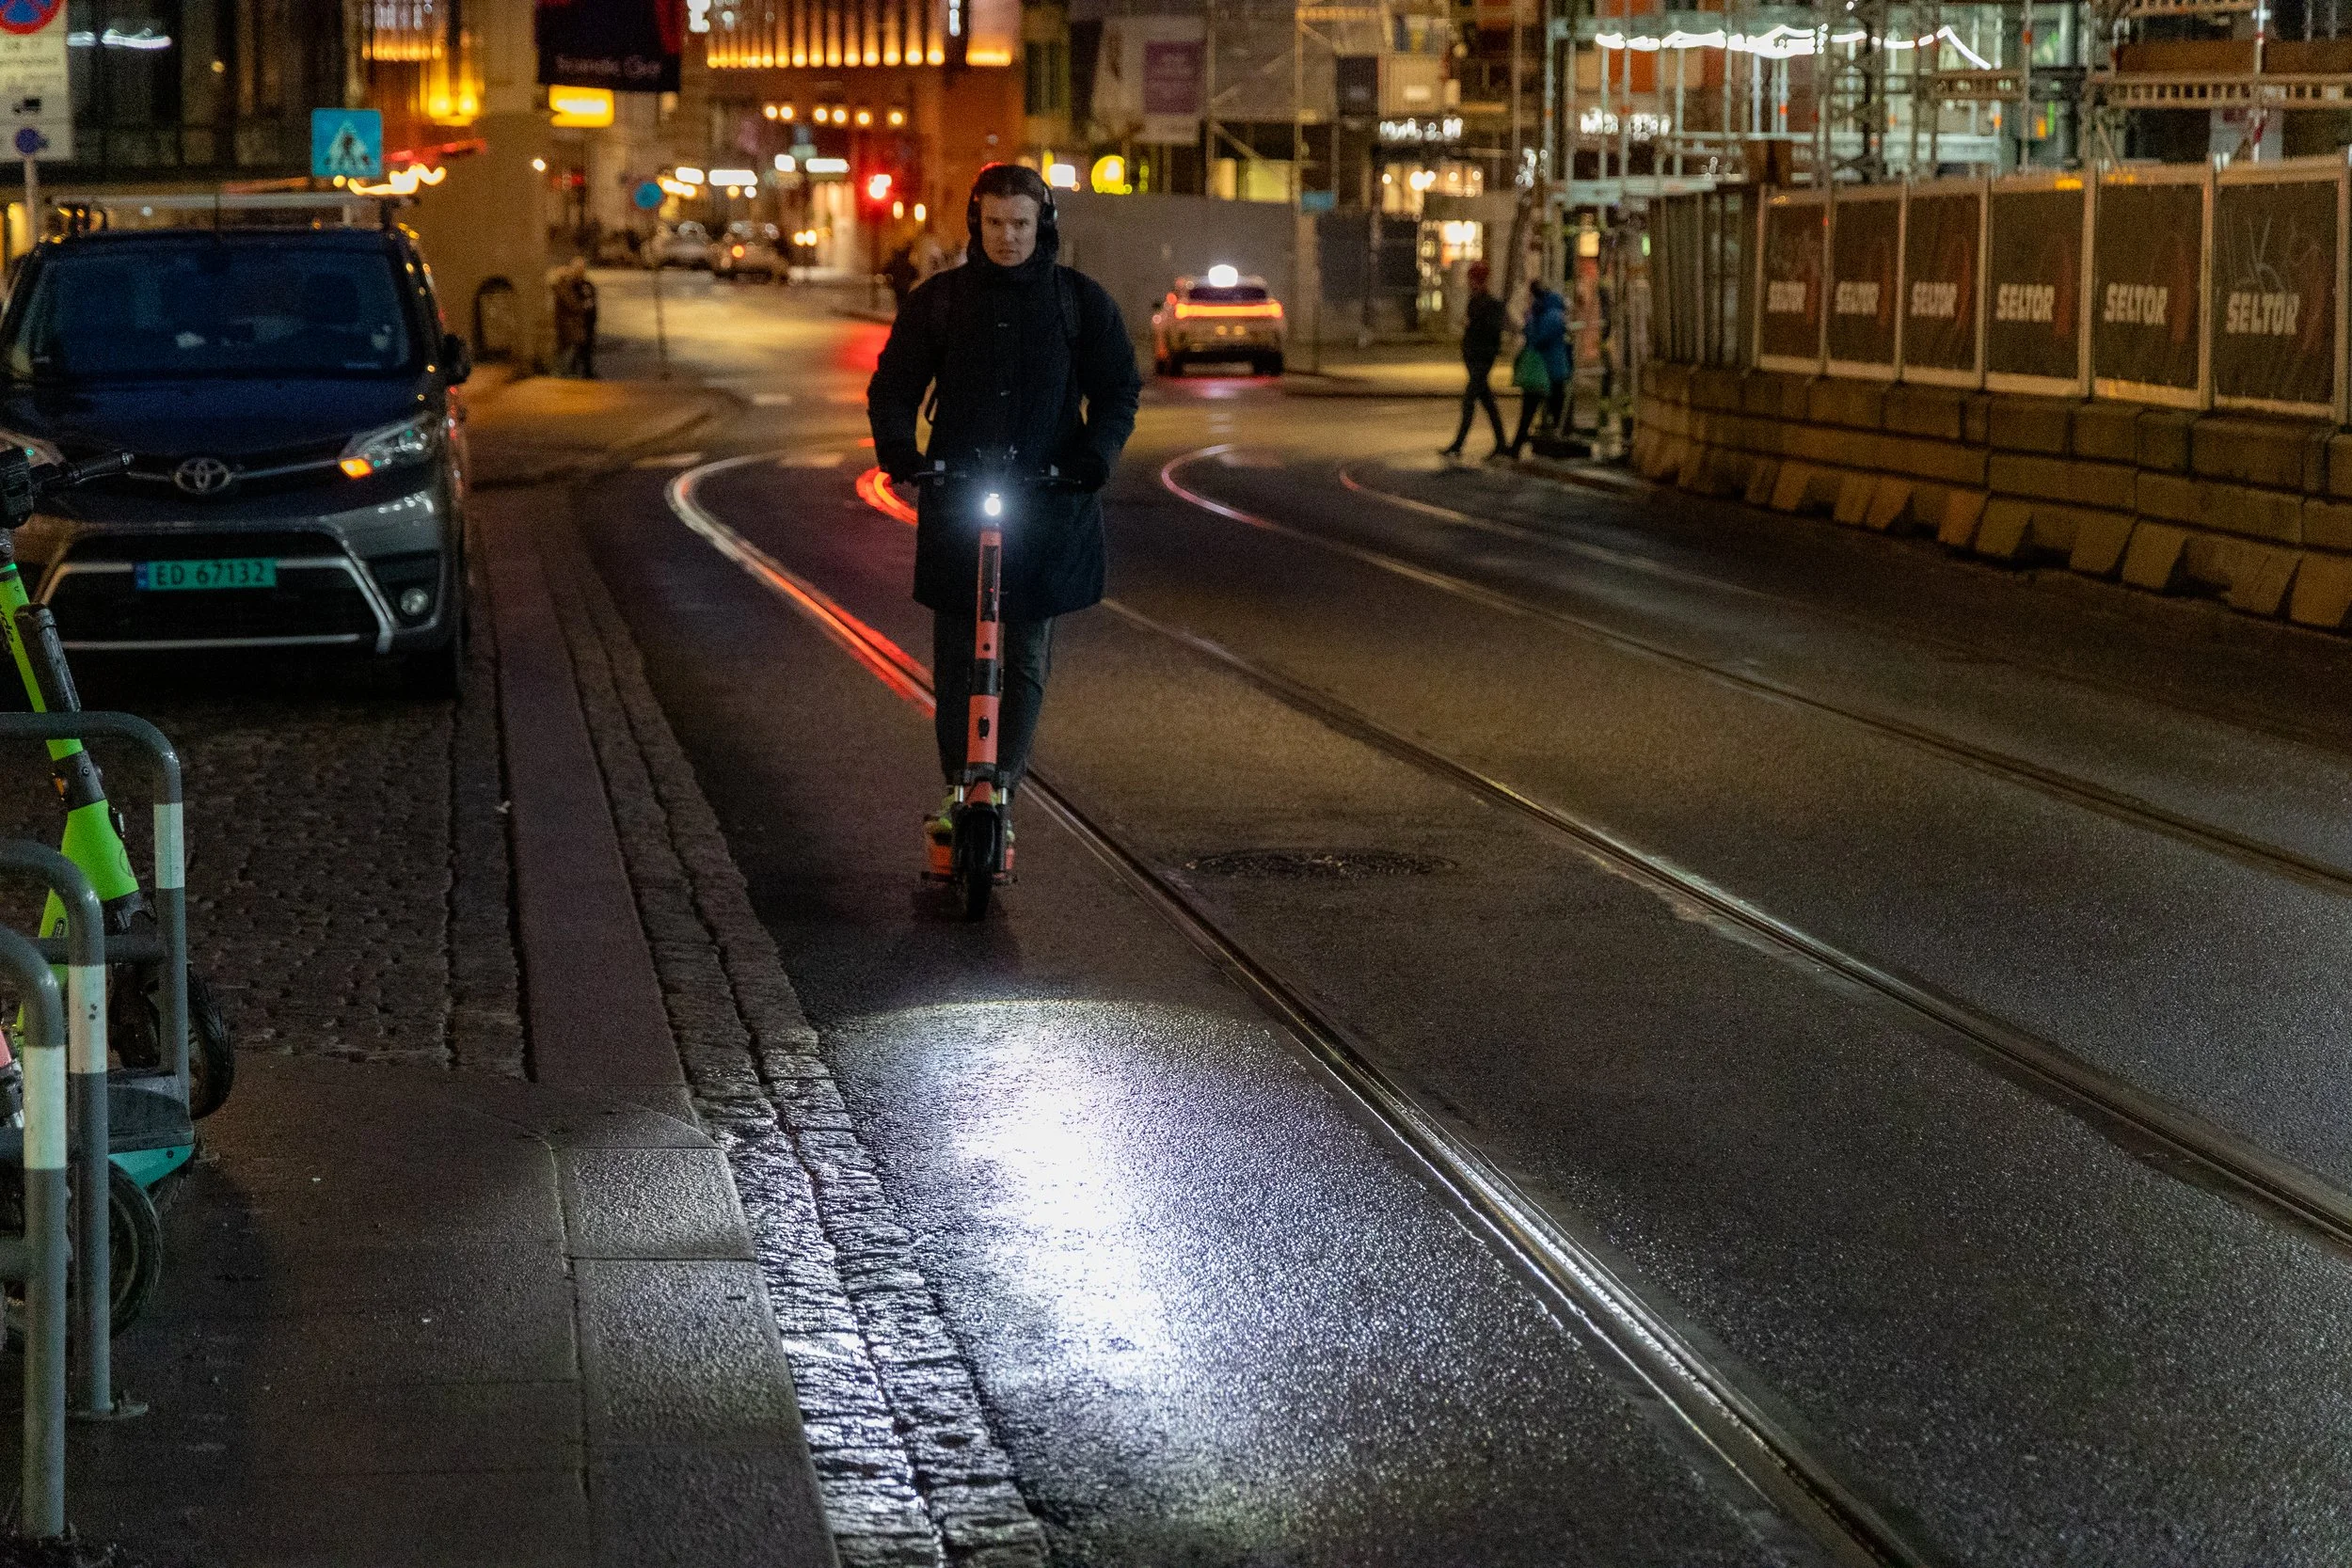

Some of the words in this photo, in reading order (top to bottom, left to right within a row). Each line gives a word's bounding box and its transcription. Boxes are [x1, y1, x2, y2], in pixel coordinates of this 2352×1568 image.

[1996, 282, 2055, 321] SELTOR
[2104, 283, 2168, 325] SELTOR
[2226, 293, 2299, 335] SELTOR
[155, 564, 185, 586] ED
[195, 562, 264, 585] 67132
